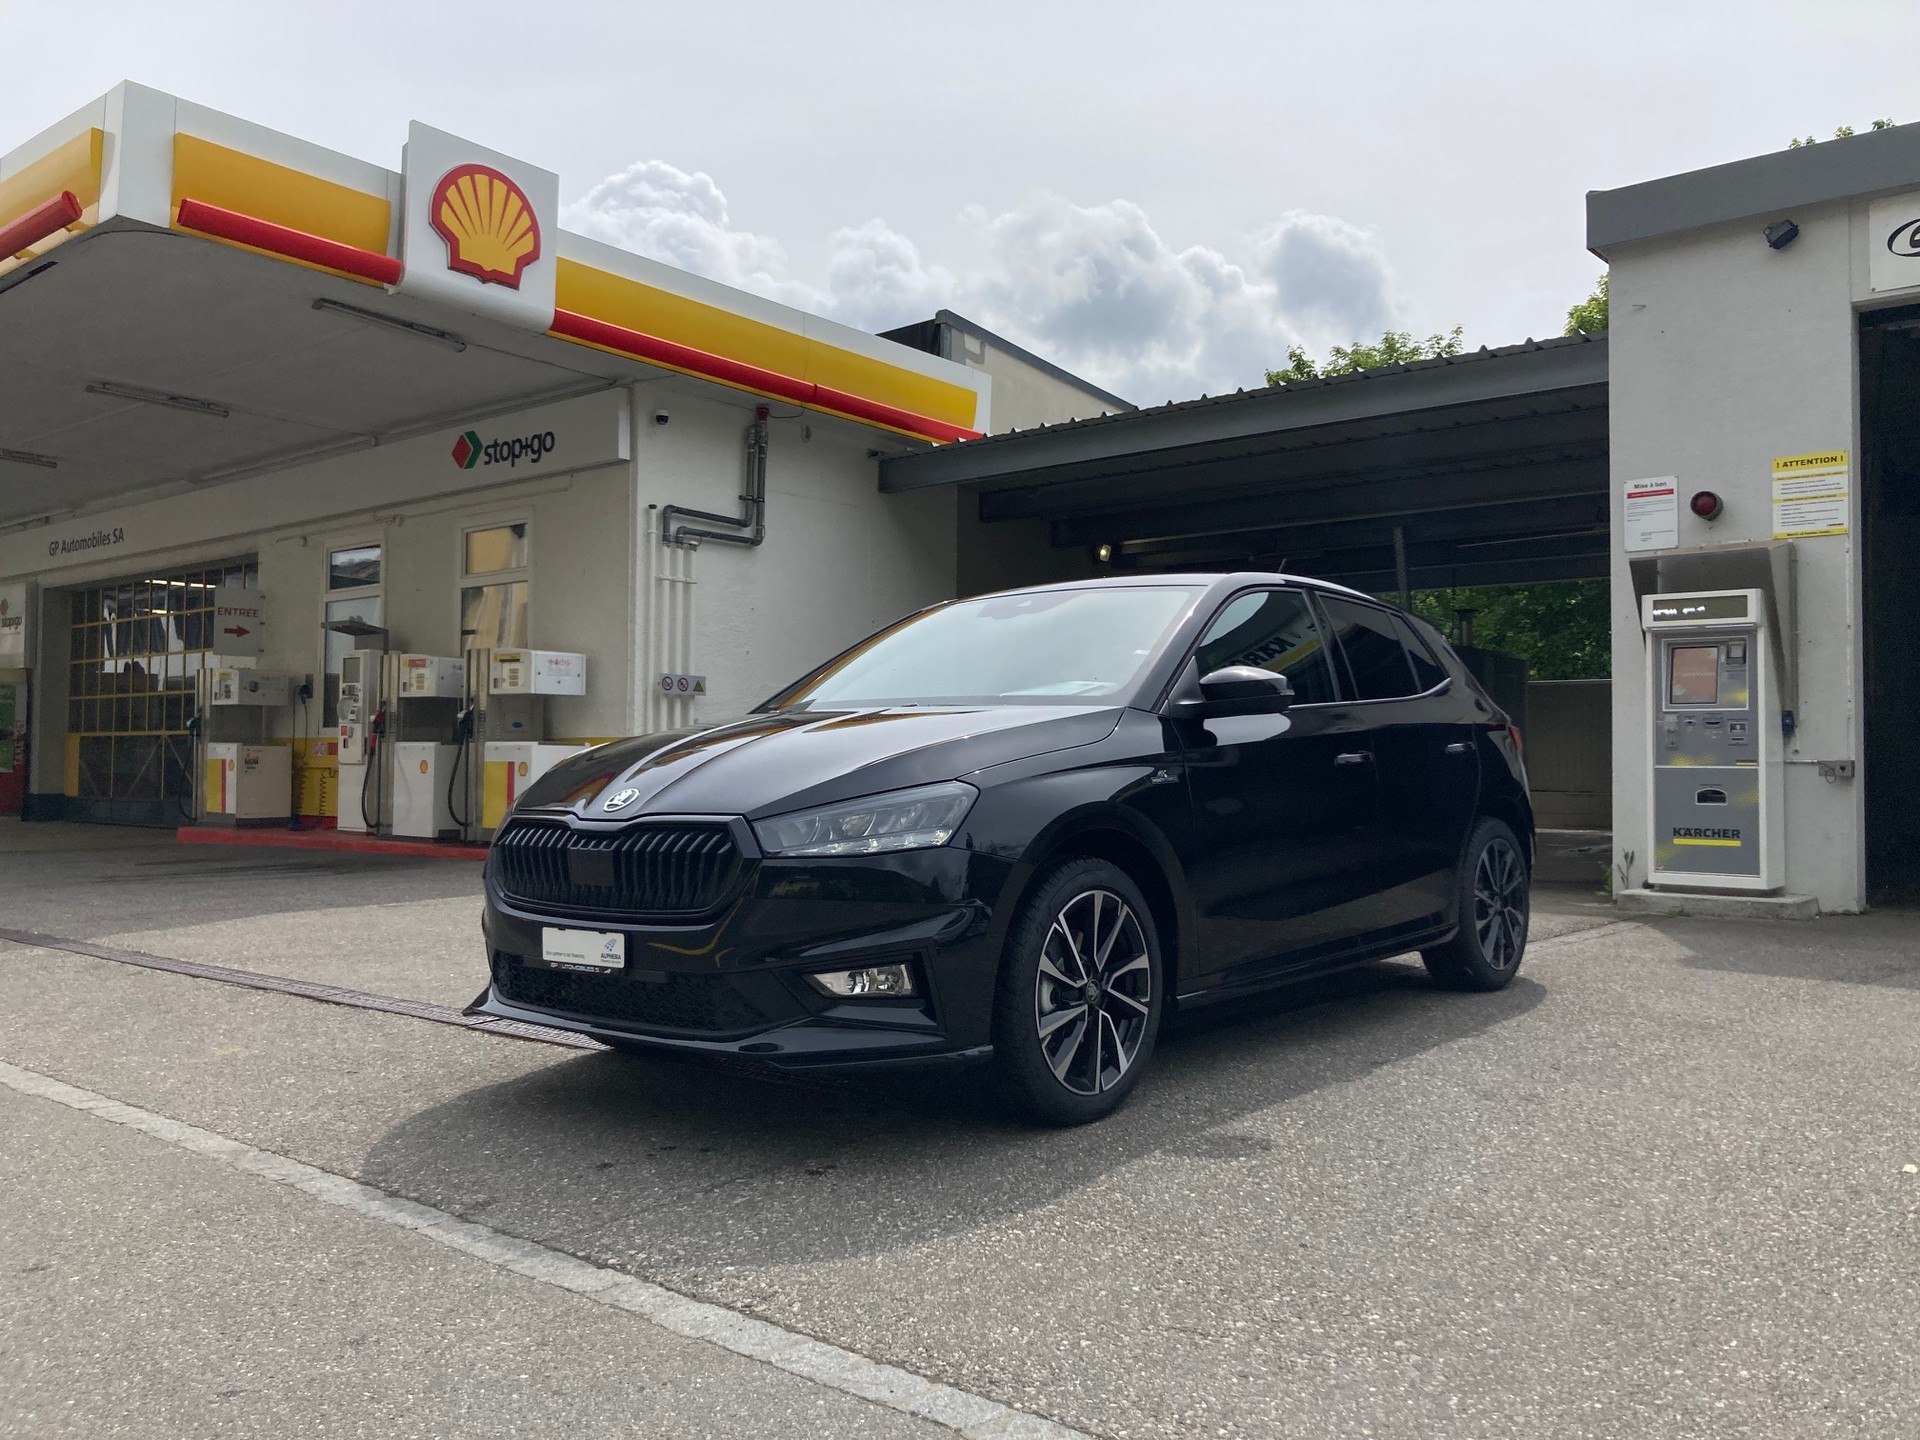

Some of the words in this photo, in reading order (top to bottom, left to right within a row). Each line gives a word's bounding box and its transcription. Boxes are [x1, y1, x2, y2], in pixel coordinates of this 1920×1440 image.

[484, 431, 555, 467] stop+go
[1782, 455, 1838, 468] ATTENTION
[49, 540, 60, 556] GP
[61, 530, 111, 554] Automobiles
[113, 527, 125, 544] SA
[1672, 826, 1741, 840] KÄRCHER
[600, 952, 622, 960] ALPHERA
